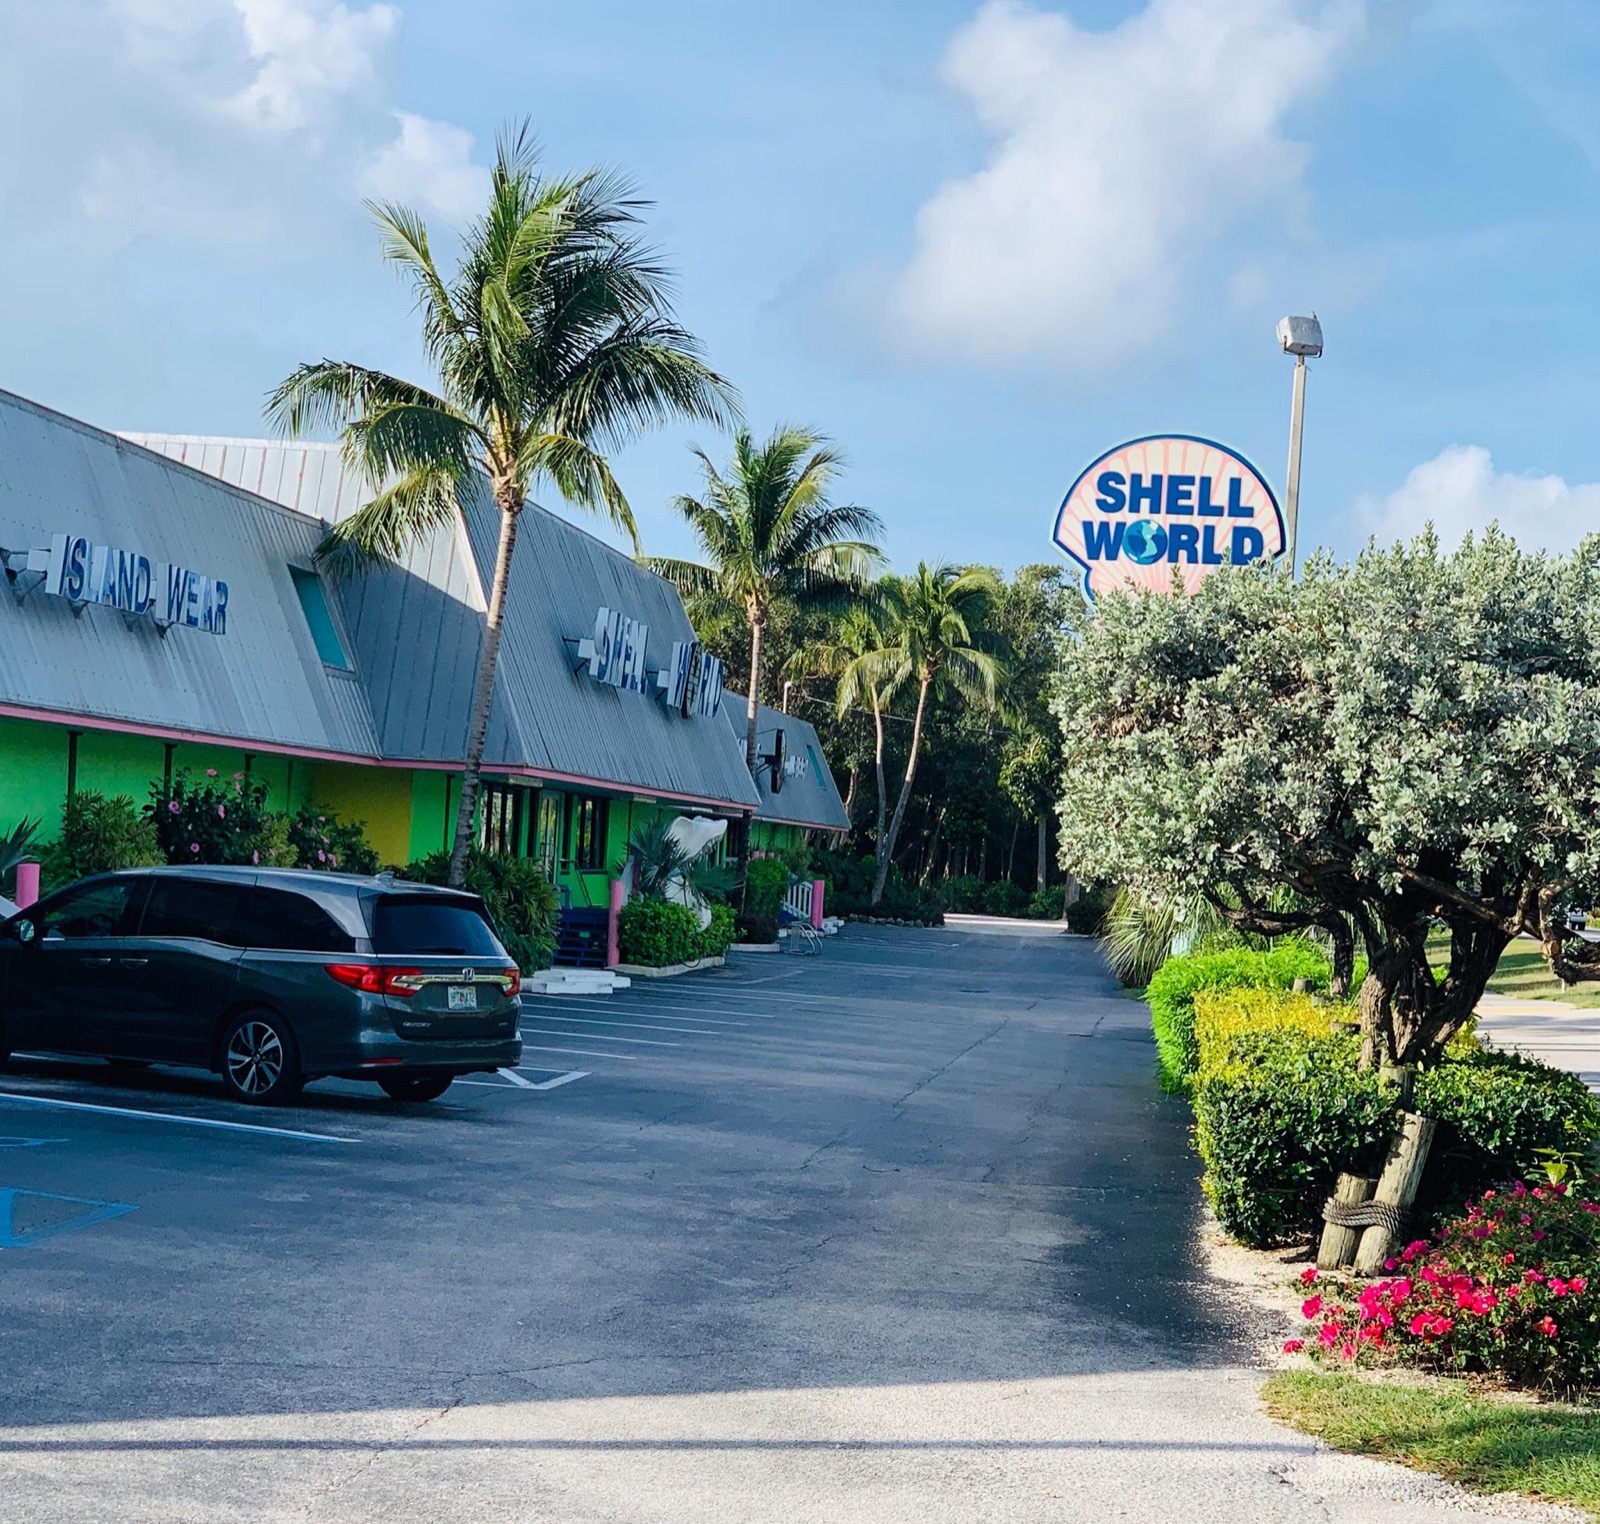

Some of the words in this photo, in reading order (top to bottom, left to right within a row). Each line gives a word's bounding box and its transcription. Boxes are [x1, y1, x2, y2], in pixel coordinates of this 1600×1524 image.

[1095, 471, 1255, 518] SHELL
[1082, 519, 1264, 566] WORLD
[46, 534, 151, 615] ISLAND
[156, 563, 229, 635] WEAR
